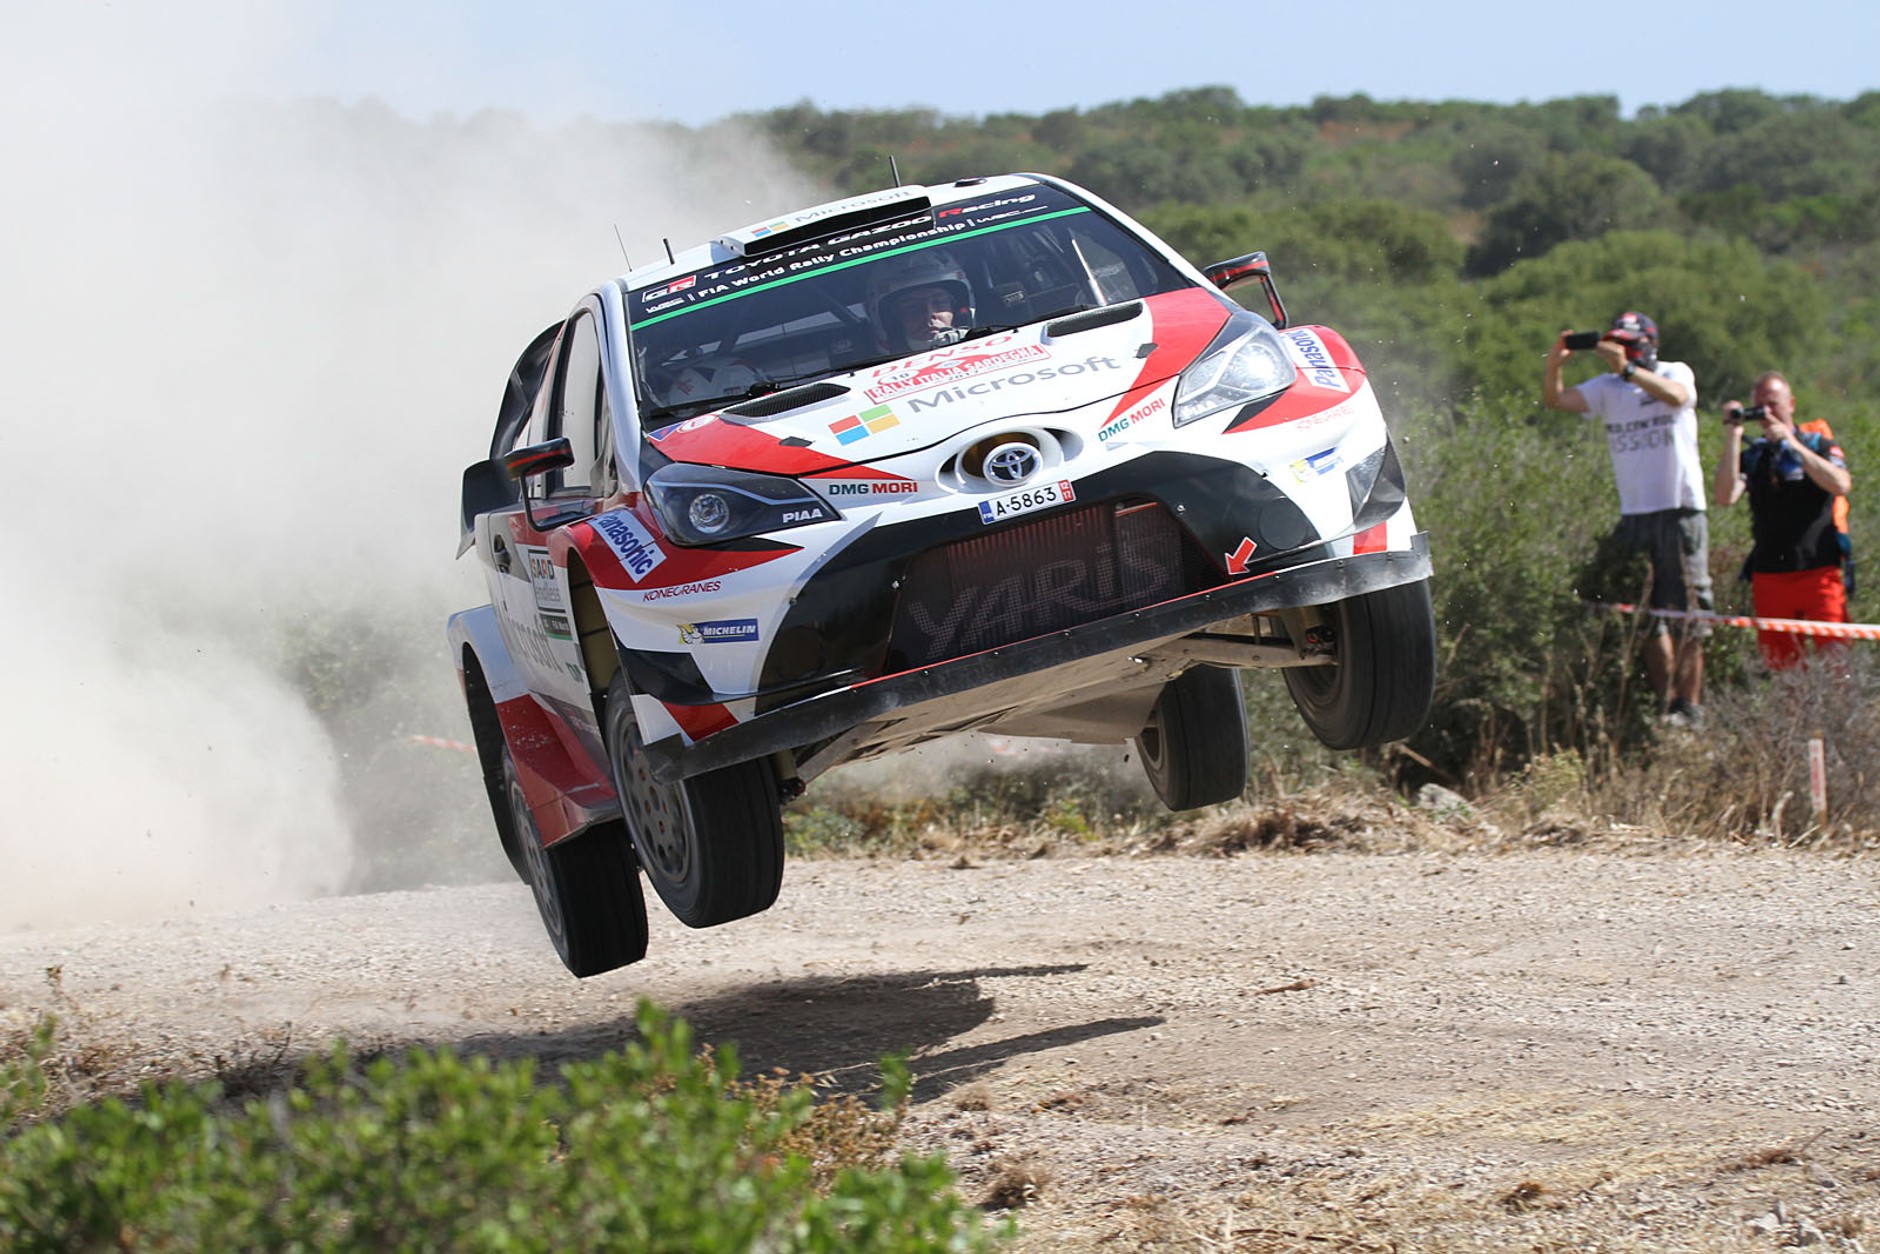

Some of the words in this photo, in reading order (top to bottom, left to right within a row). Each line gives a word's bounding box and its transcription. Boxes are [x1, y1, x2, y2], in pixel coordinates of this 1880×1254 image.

[704, 242, 821, 280] TOYOTA
[827, 215, 932, 246] GAZOO
[938, 194, 1036, 219] Racing
[698, 284, 730, 298] FIA
[731, 267, 786, 287] World
[789, 252, 835, 276] Rally
[839, 222, 966, 257] Championship
[643, 275, 696, 302] GR
[872, 336, 1012, 378] DENSO
[872, 379, 919, 399] RALLY
[918, 364, 965, 386] ITALIA
[964, 343, 1040, 373] SARDEGNA
[906, 355, 1121, 413] Microsoft
[1098, 418, 1130, 442] DMG
[1129, 397, 1166, 425] MORI
[828, 483, 869, 495] DMG
[871, 481, 919, 495] MORI
[782, 507, 823, 523] PIAA
[642, 580, 722, 603] KONECRANES
[908, 535, 1170, 658] YARIS
[702, 624, 757, 636] MICHELIN
